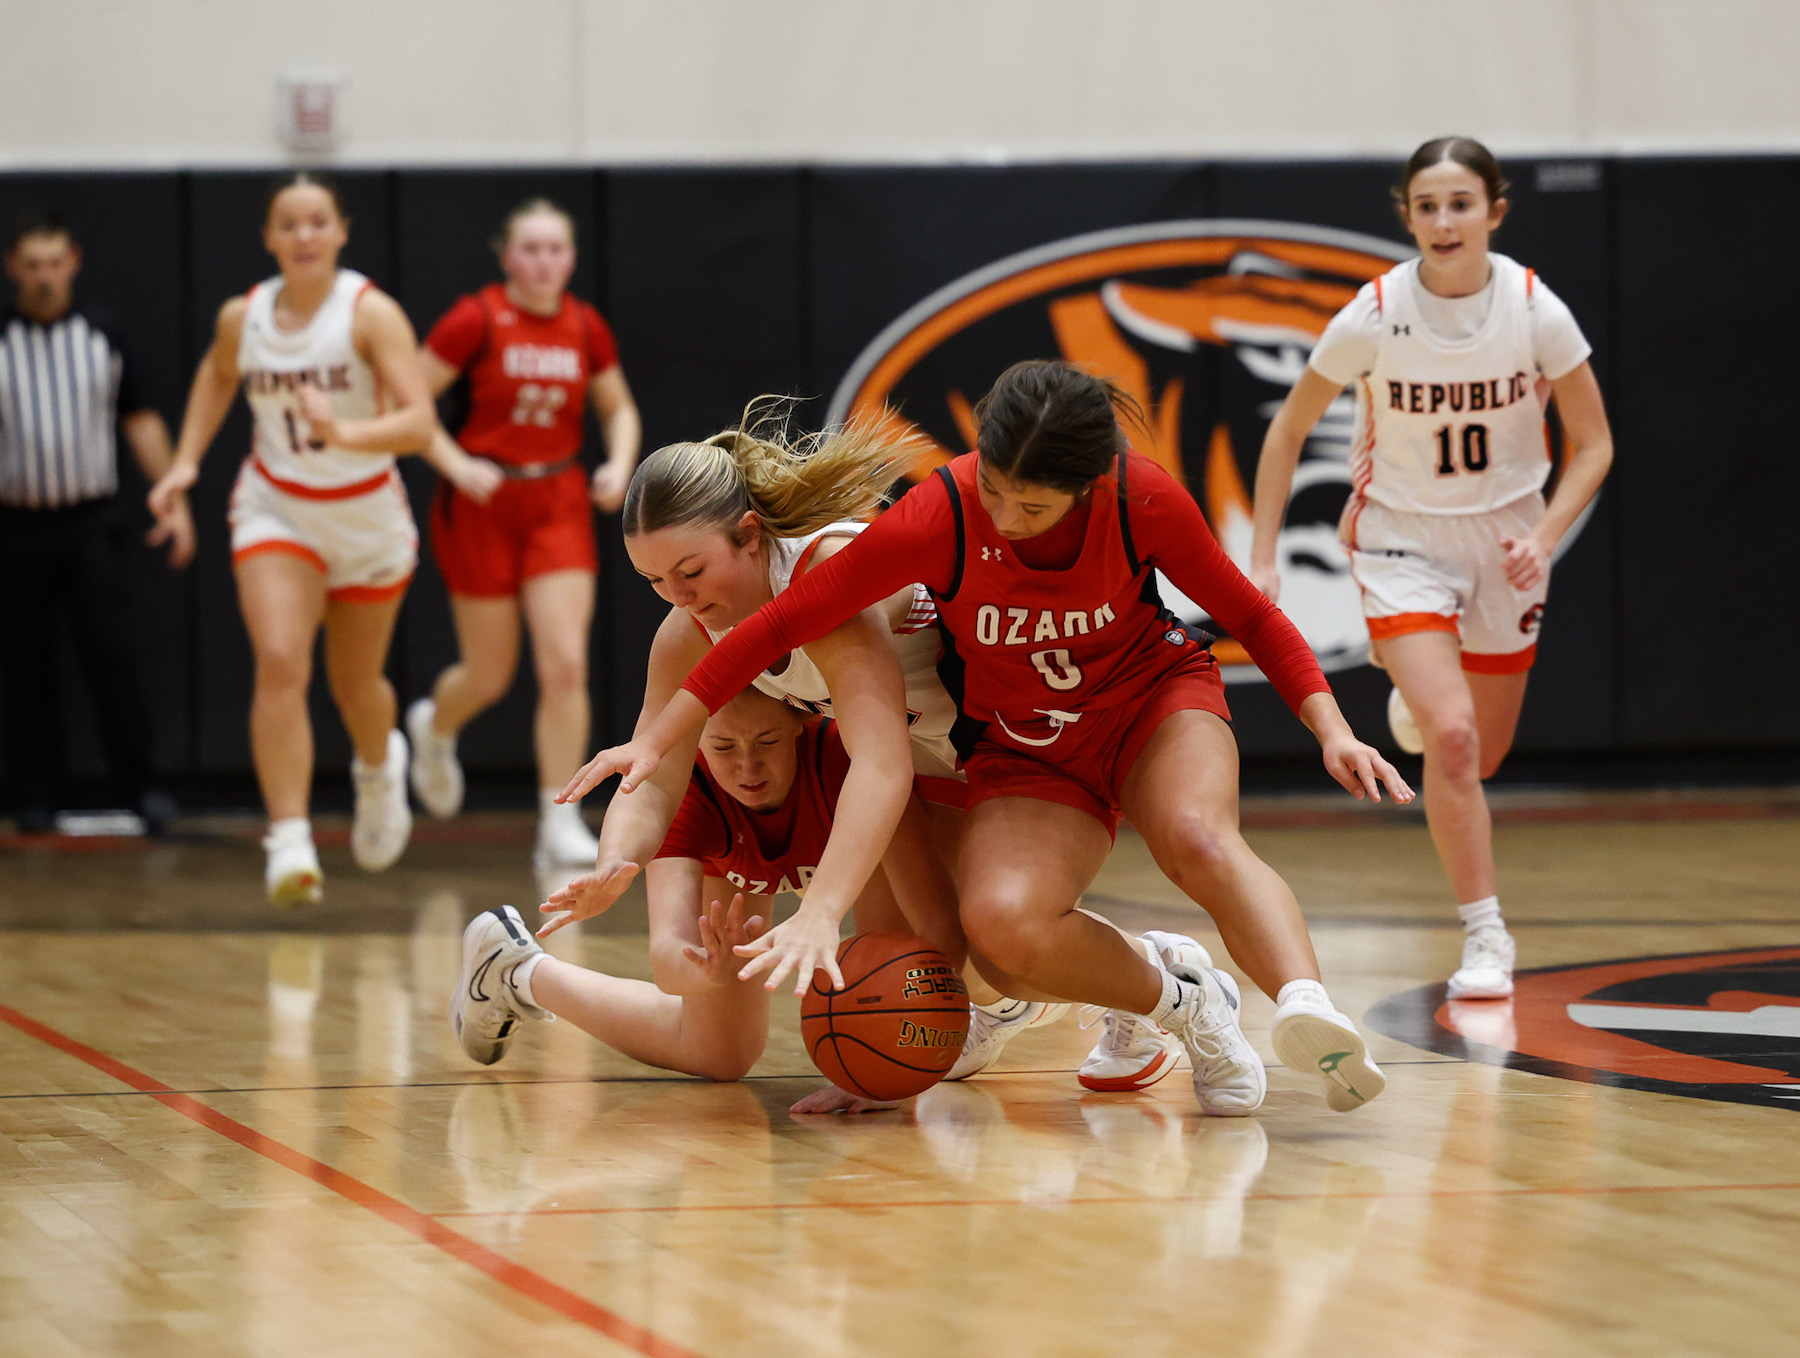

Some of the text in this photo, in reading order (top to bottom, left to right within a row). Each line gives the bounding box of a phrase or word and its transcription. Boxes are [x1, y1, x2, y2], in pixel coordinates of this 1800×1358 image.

[1386, 371, 1526, 413] REPUBLIC
[1434, 422, 1491, 478] 10
[1030, 648, 1084, 692] 0
